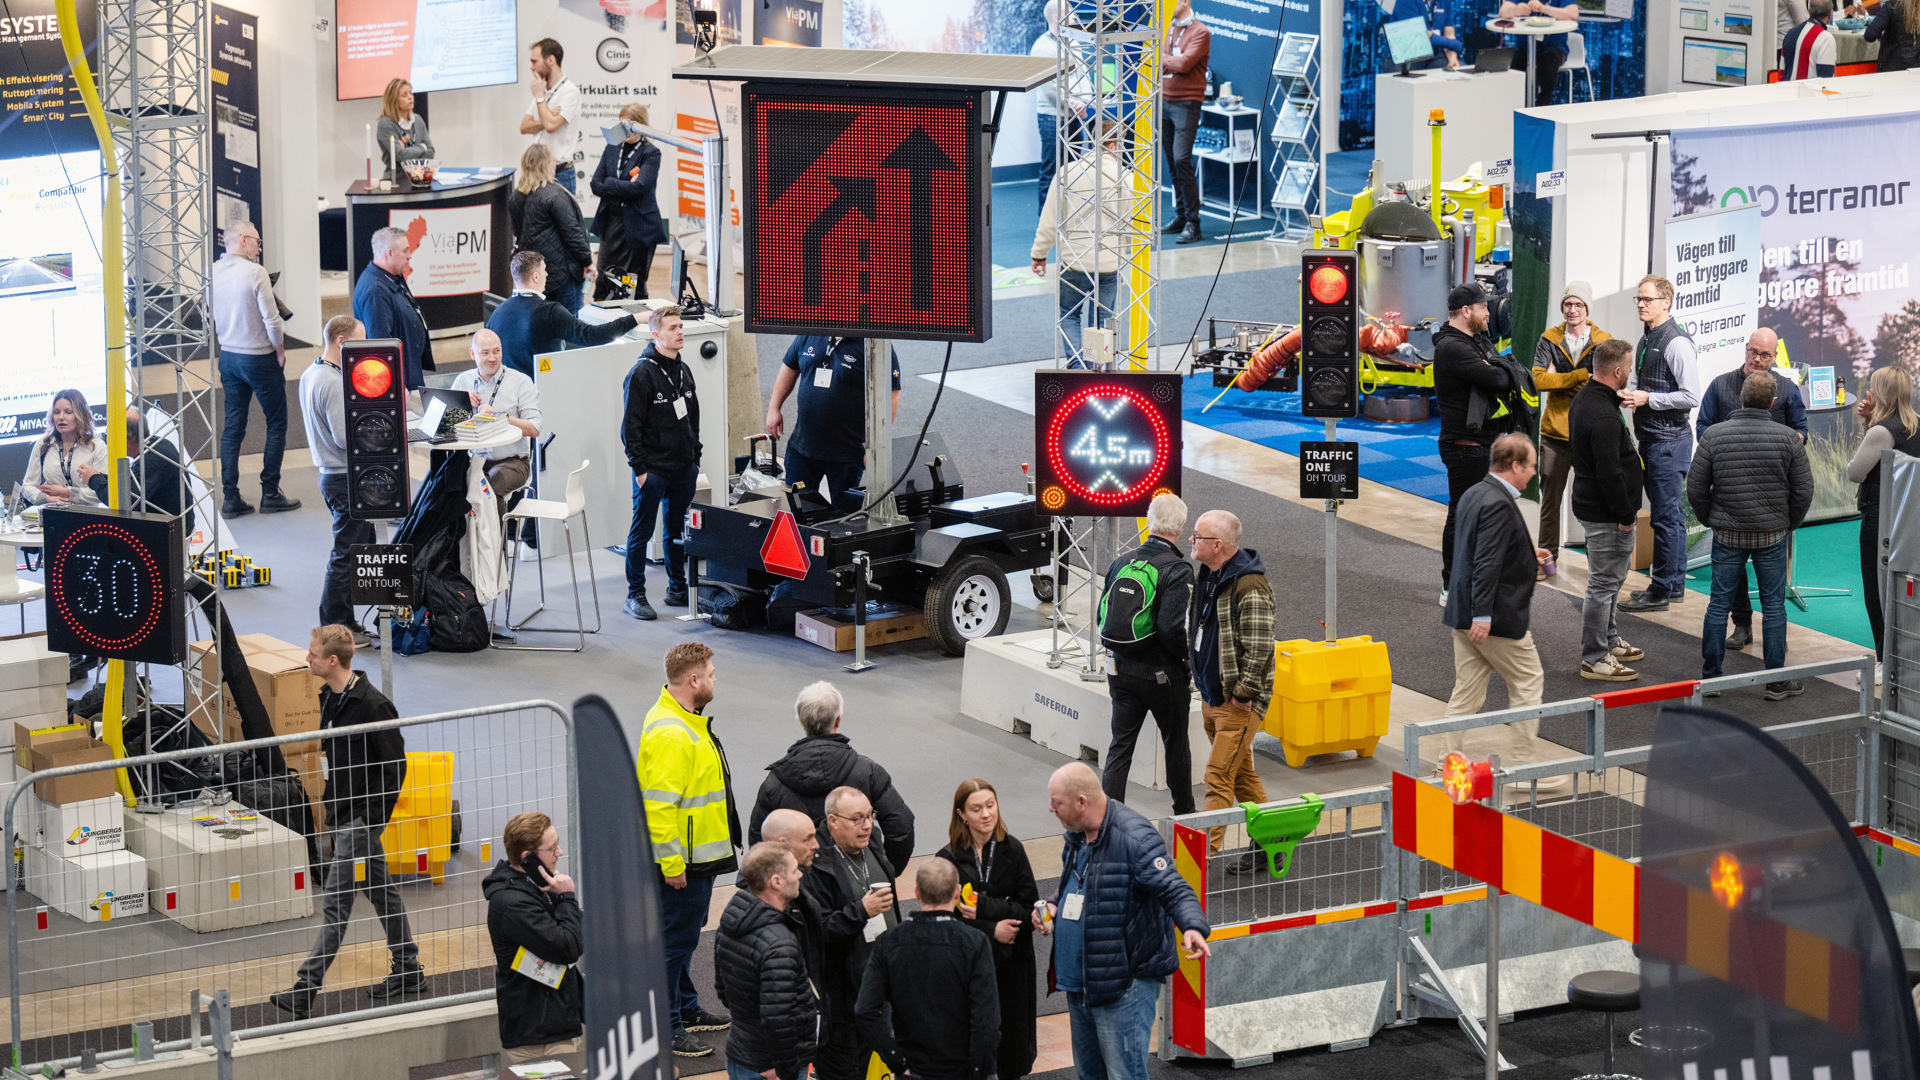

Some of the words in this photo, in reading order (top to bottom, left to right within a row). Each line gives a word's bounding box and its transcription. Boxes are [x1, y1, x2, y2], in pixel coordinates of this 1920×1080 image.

[786, 6, 818, 30] ViaPM
[0, 14, 59, 36] SYSTE
[46, 31, 61, 41] Syst
[606, 50, 631, 59] Cinis
[578, 85, 629, 95] irkulärt
[633, 85, 658, 95] salt
[49, 112, 65, 121] City
[1786, 181, 1911, 214] terranor
[431, 229, 487, 255] ViaPM
[1676, 242, 1715, 263] Vägen
[1718, 234, 1735, 254] till
[1799, 236, 1829, 265] till
[1835, 238, 1863, 261] en
[1676, 270, 1691, 286] en
[1695, 259, 1748, 284] tryggare
[1827, 263, 1909, 297] framtid
[1676, 284, 1721, 310] framtid
[1700, 314, 1746, 334] terranor
[20, 418, 48, 431] MIYAG
[1305, 450, 1353, 460] TRAFFIC
[1305, 462, 1331, 472] ONE
[1306, 473, 1319, 482] ON
[1321, 473, 1347, 483] TOUR
[356, 554, 407, 564] TRAFFIC
[356, 567, 384, 577] ONE
[76, 554, 138, 618] 30
[357, 579, 371, 588] ON
[374, 579, 401, 588] TOUR
[1034, 692, 1079, 720] SAFEROAD
[80, 827, 122, 838] LJUNGBERGS
[99, 838, 121, 846] KLIPPAN
[110, 892, 145, 902] UNGBERGS
[121, 903, 144, 911] KLIPPAN
